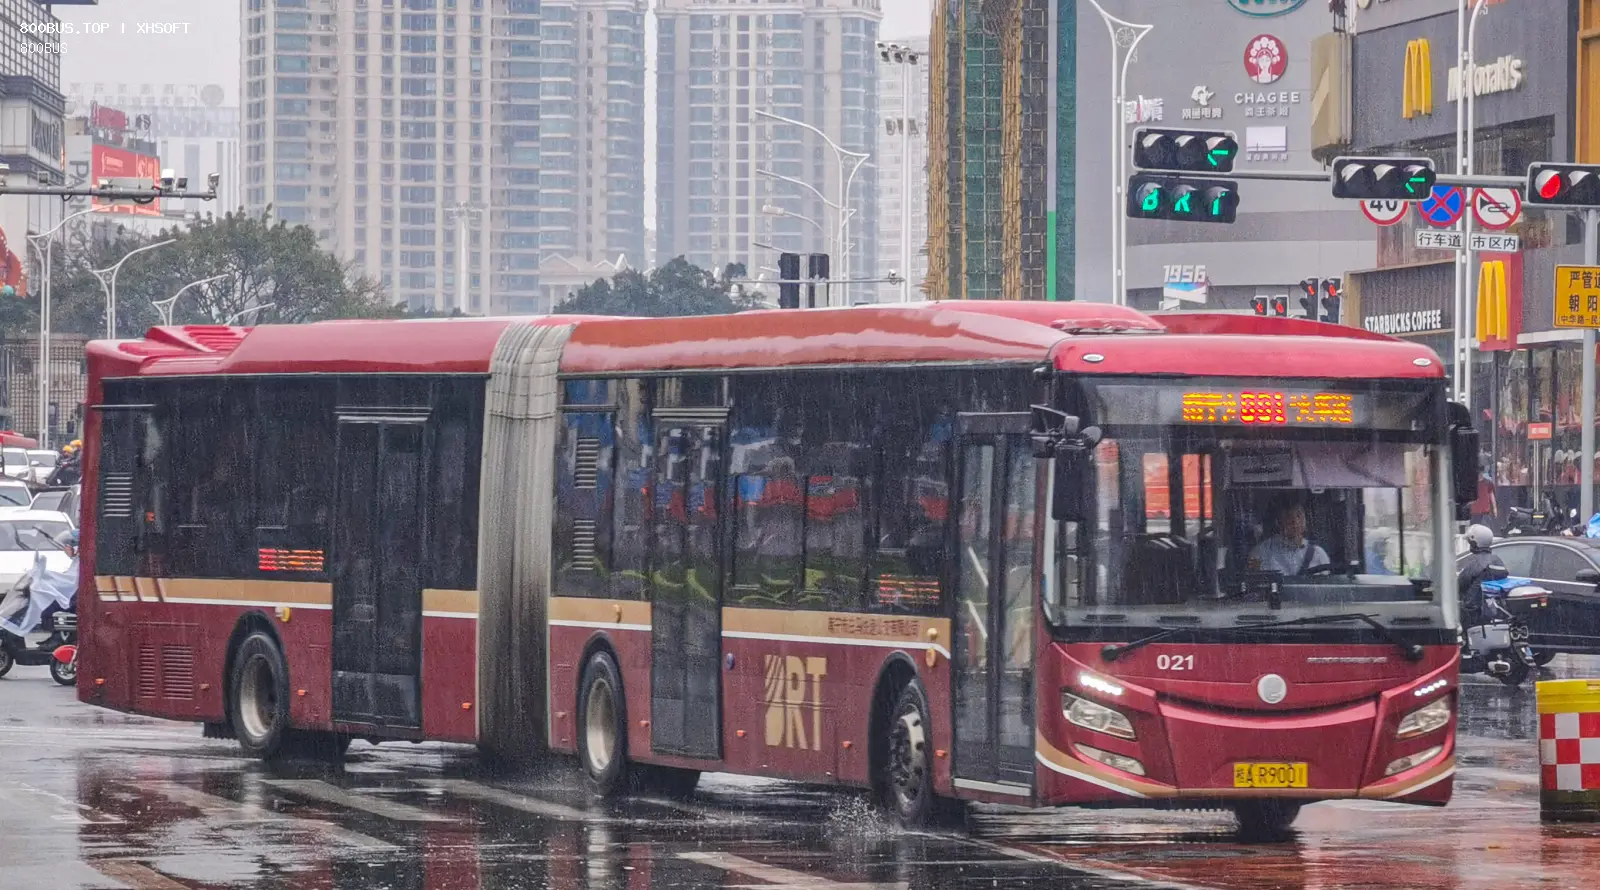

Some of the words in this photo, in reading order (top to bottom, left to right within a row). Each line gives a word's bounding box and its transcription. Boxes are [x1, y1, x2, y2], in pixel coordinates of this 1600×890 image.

[1234, 92, 1300, 104] CHAGEE
[1418, 232, 1462, 248] 行车道
[1472, 236, 1517, 251] 市区内
[1163, 264, 1206, 283] 1956
[1364, 311, 1411, 335] STARBUCKS
[1411, 309, 1442, 332] COFFEE
[1156, 654, 1194, 671] 021
